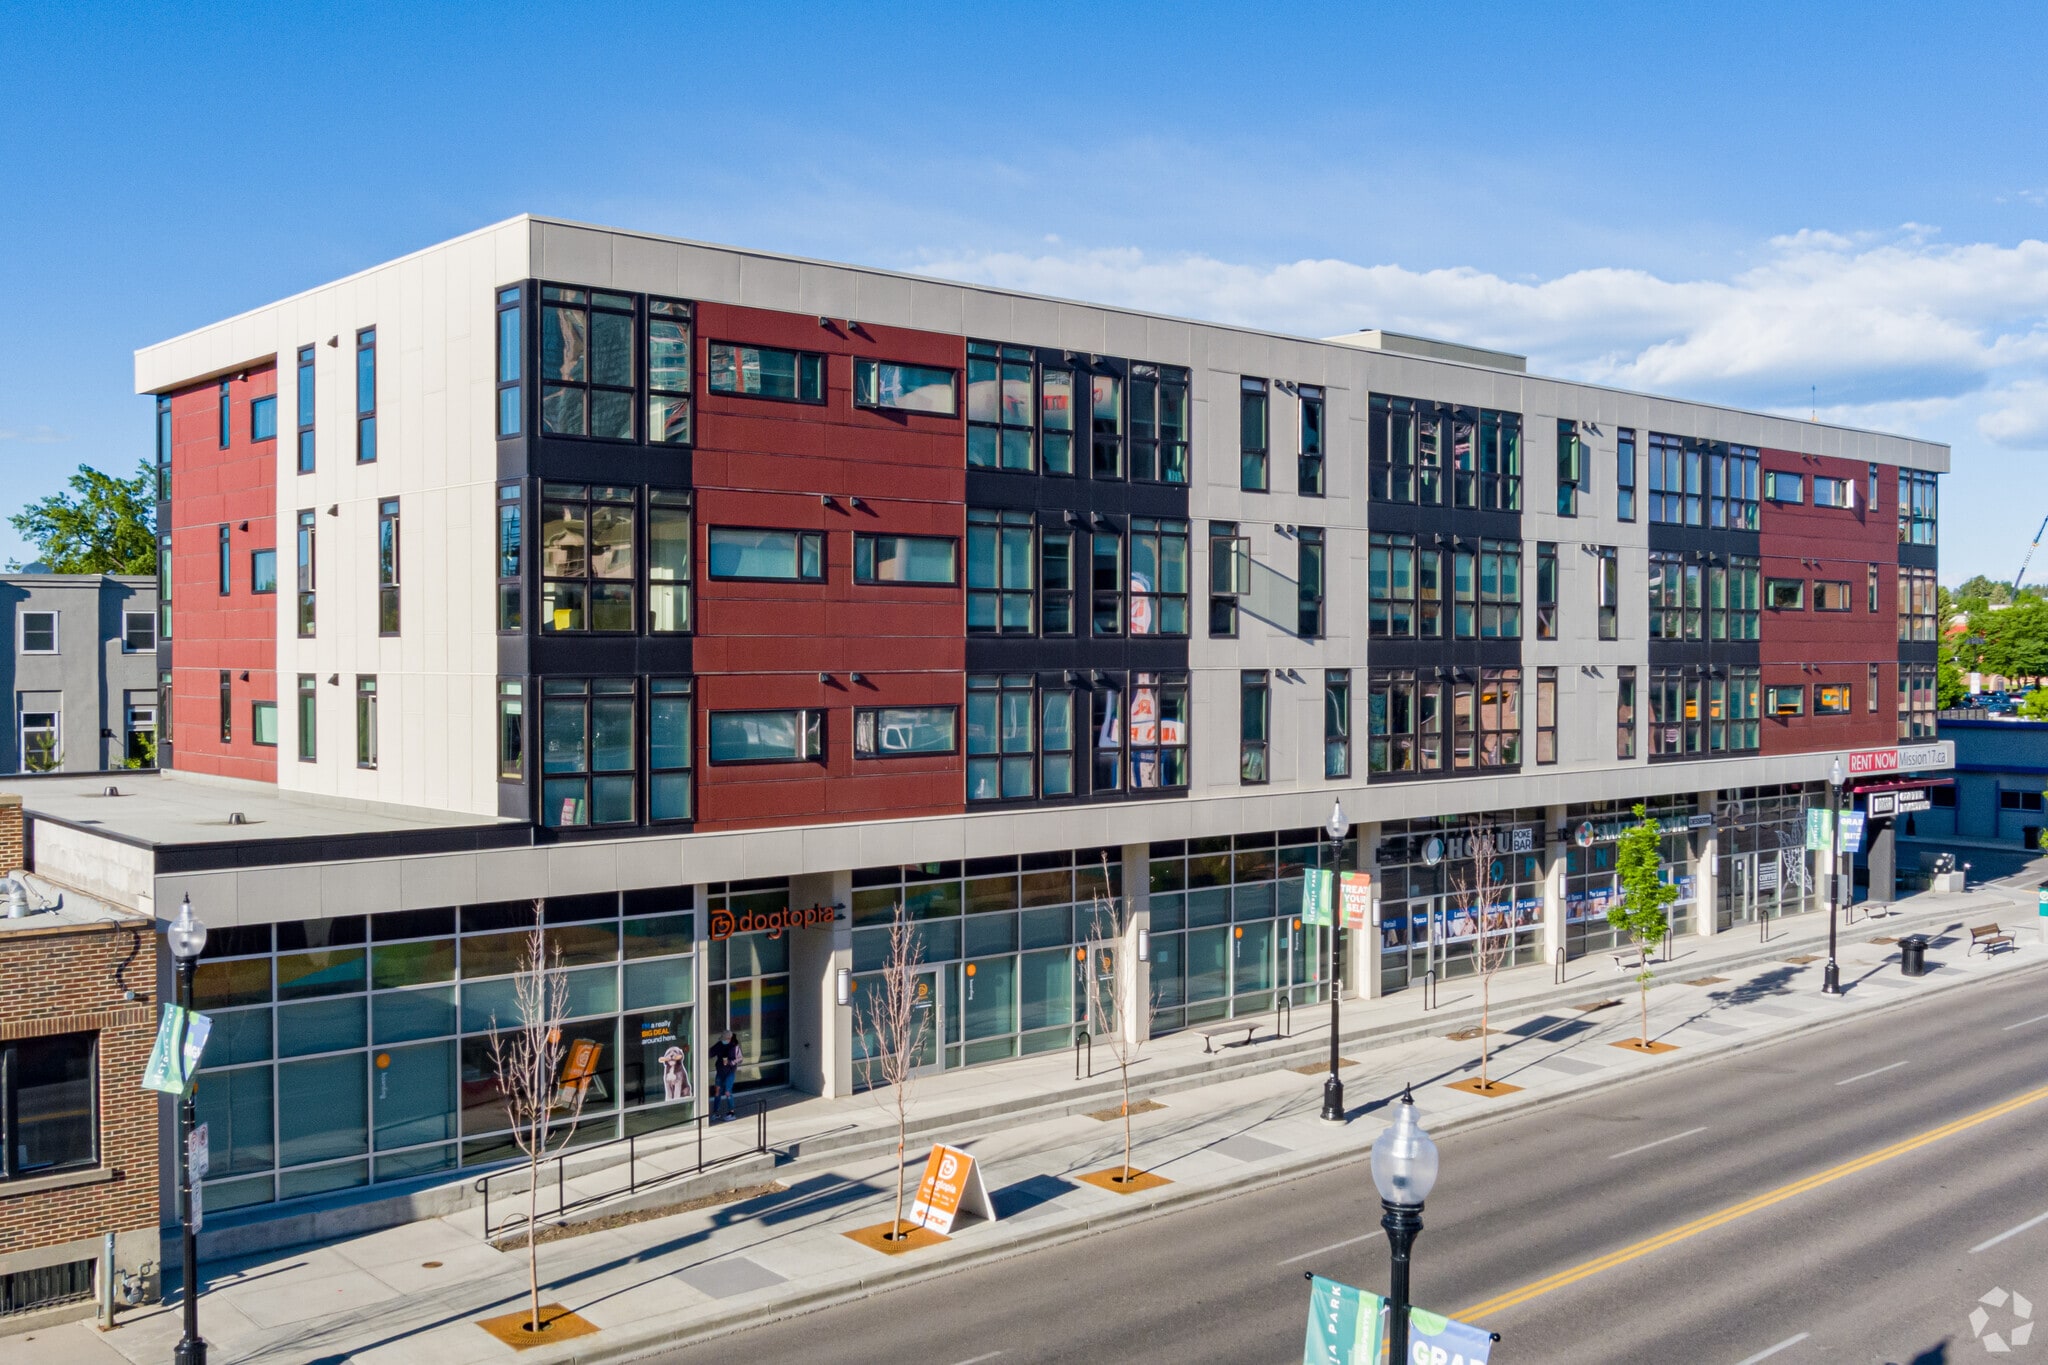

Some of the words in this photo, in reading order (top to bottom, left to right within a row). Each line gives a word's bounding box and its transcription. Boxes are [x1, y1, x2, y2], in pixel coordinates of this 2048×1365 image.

[1851, 753, 1873, 771] RENT
[1875, 751, 1897, 769] NOW
[1900, 749, 1946, 767] Mission17.ca
[1514, 830, 1531, 838] POKE
[1514, 839, 1531, 850] BAR
[1341, 884, 1367, 894] TREAT
[1344, 894, 1366, 903] YOUR
[1346, 903, 1365, 913] SELF
[740, 903, 835, 940] dogtopia
[655, 1020, 671, 1028] really
[641, 1030, 653, 1038] BIG
[653, 1028, 670, 1036] DEAL
[641, 1036, 662, 1045] around
[1328, 1285, 1342, 1335] PARK
